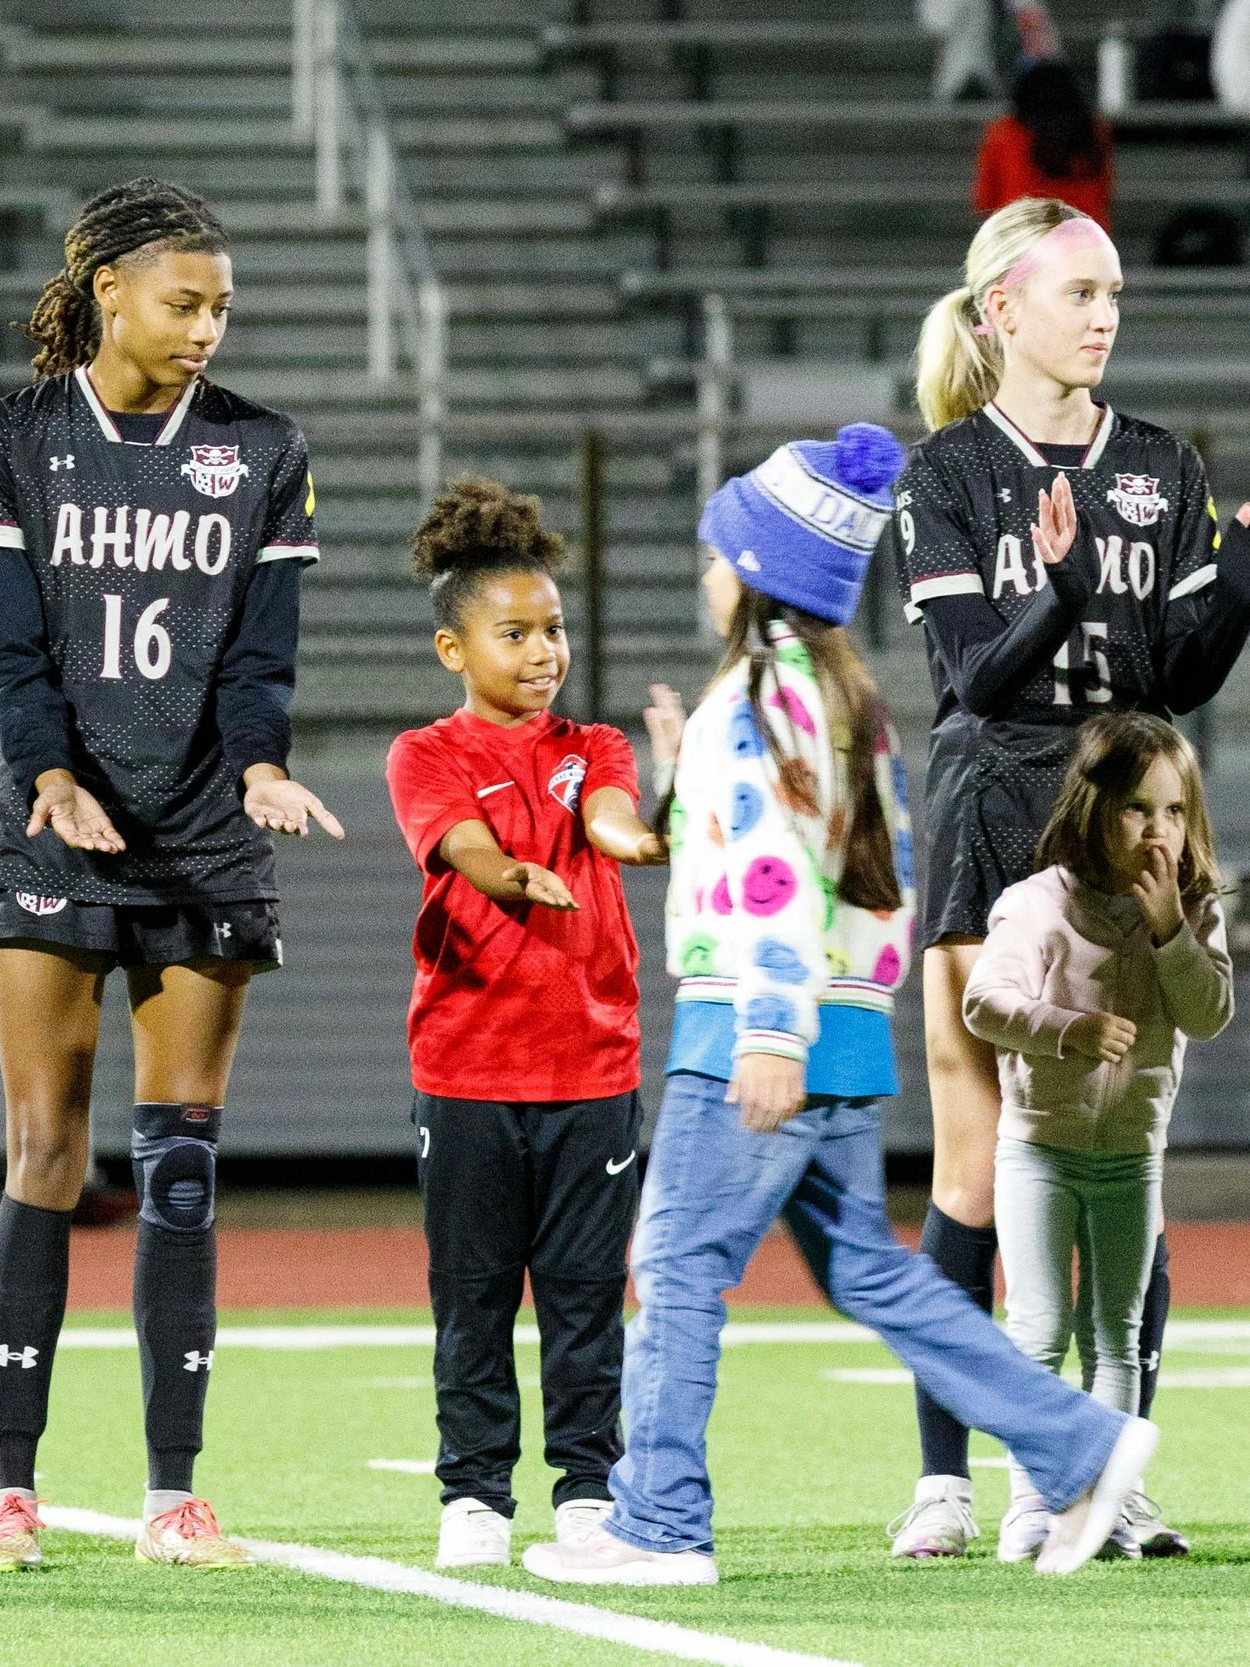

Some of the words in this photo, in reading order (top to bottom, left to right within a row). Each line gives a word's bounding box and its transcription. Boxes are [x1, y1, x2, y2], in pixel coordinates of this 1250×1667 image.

[50, 503, 231, 576] AHMO
[900, 509, 915, 556] 9
[99, 594, 171, 679] 16
[1051, 621, 1114, 704] 15
